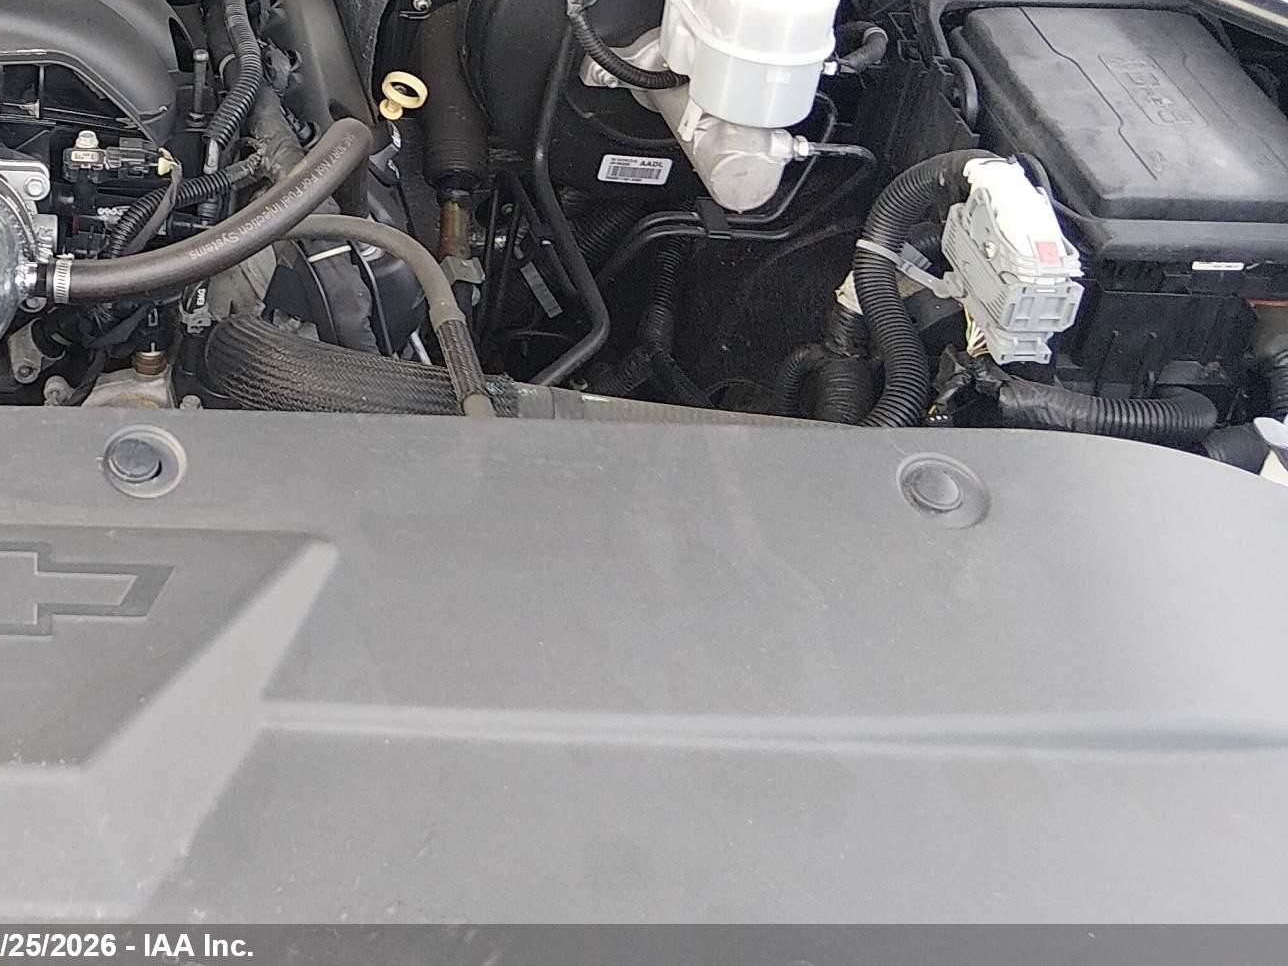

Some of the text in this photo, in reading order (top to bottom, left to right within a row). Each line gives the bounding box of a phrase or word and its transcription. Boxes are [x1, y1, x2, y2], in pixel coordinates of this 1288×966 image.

[314, 158, 331, 178] Not
[299, 171, 317, 190] For
[281, 186, 304, 209] Fuel
[239, 199, 282, 236] Injection
